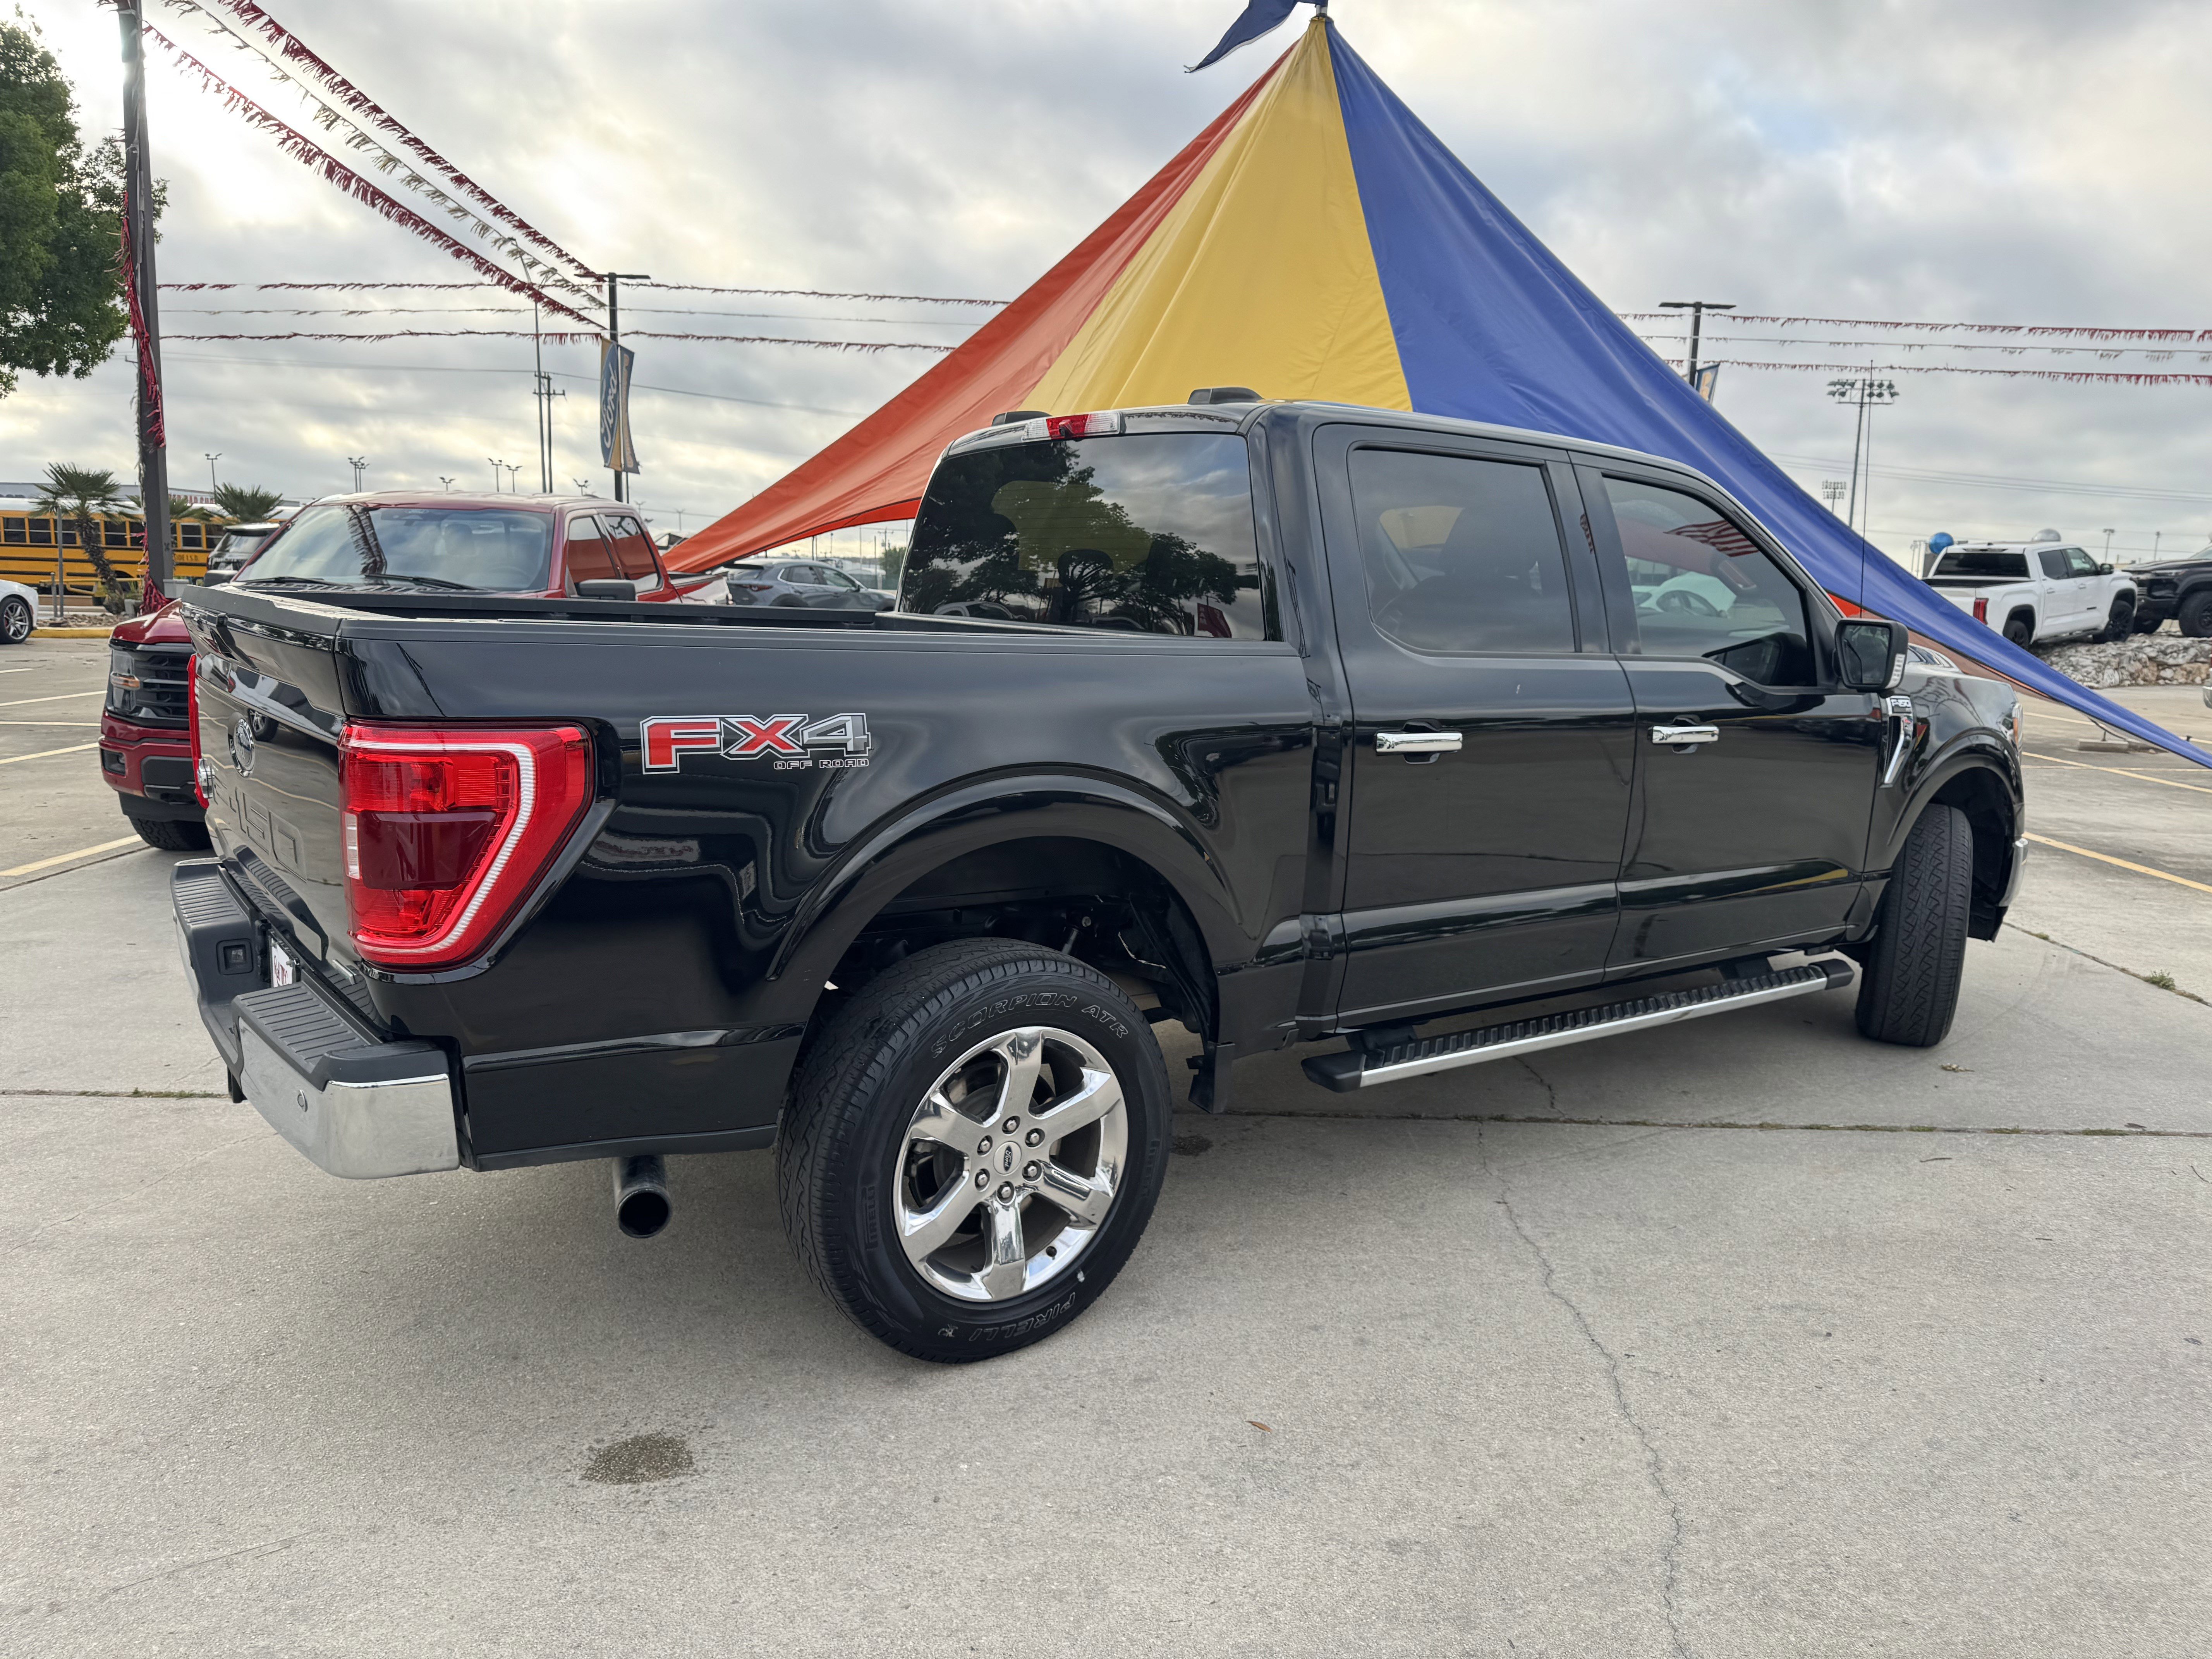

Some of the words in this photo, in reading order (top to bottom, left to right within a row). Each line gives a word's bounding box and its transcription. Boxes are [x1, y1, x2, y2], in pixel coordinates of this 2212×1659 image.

[601, 363, 618, 449] Ford
[640, 713, 871, 775] FX4
[774, 760, 812, 770] OFF
[819, 758, 869, 768] ROAD
[931, 993, 1077, 1058] SCORPION
[1082, 1005, 1128, 1039] ATR
[861, 1186, 879, 1250] PIRELLI
[969, 1292, 1075, 1341] PIRELLI
